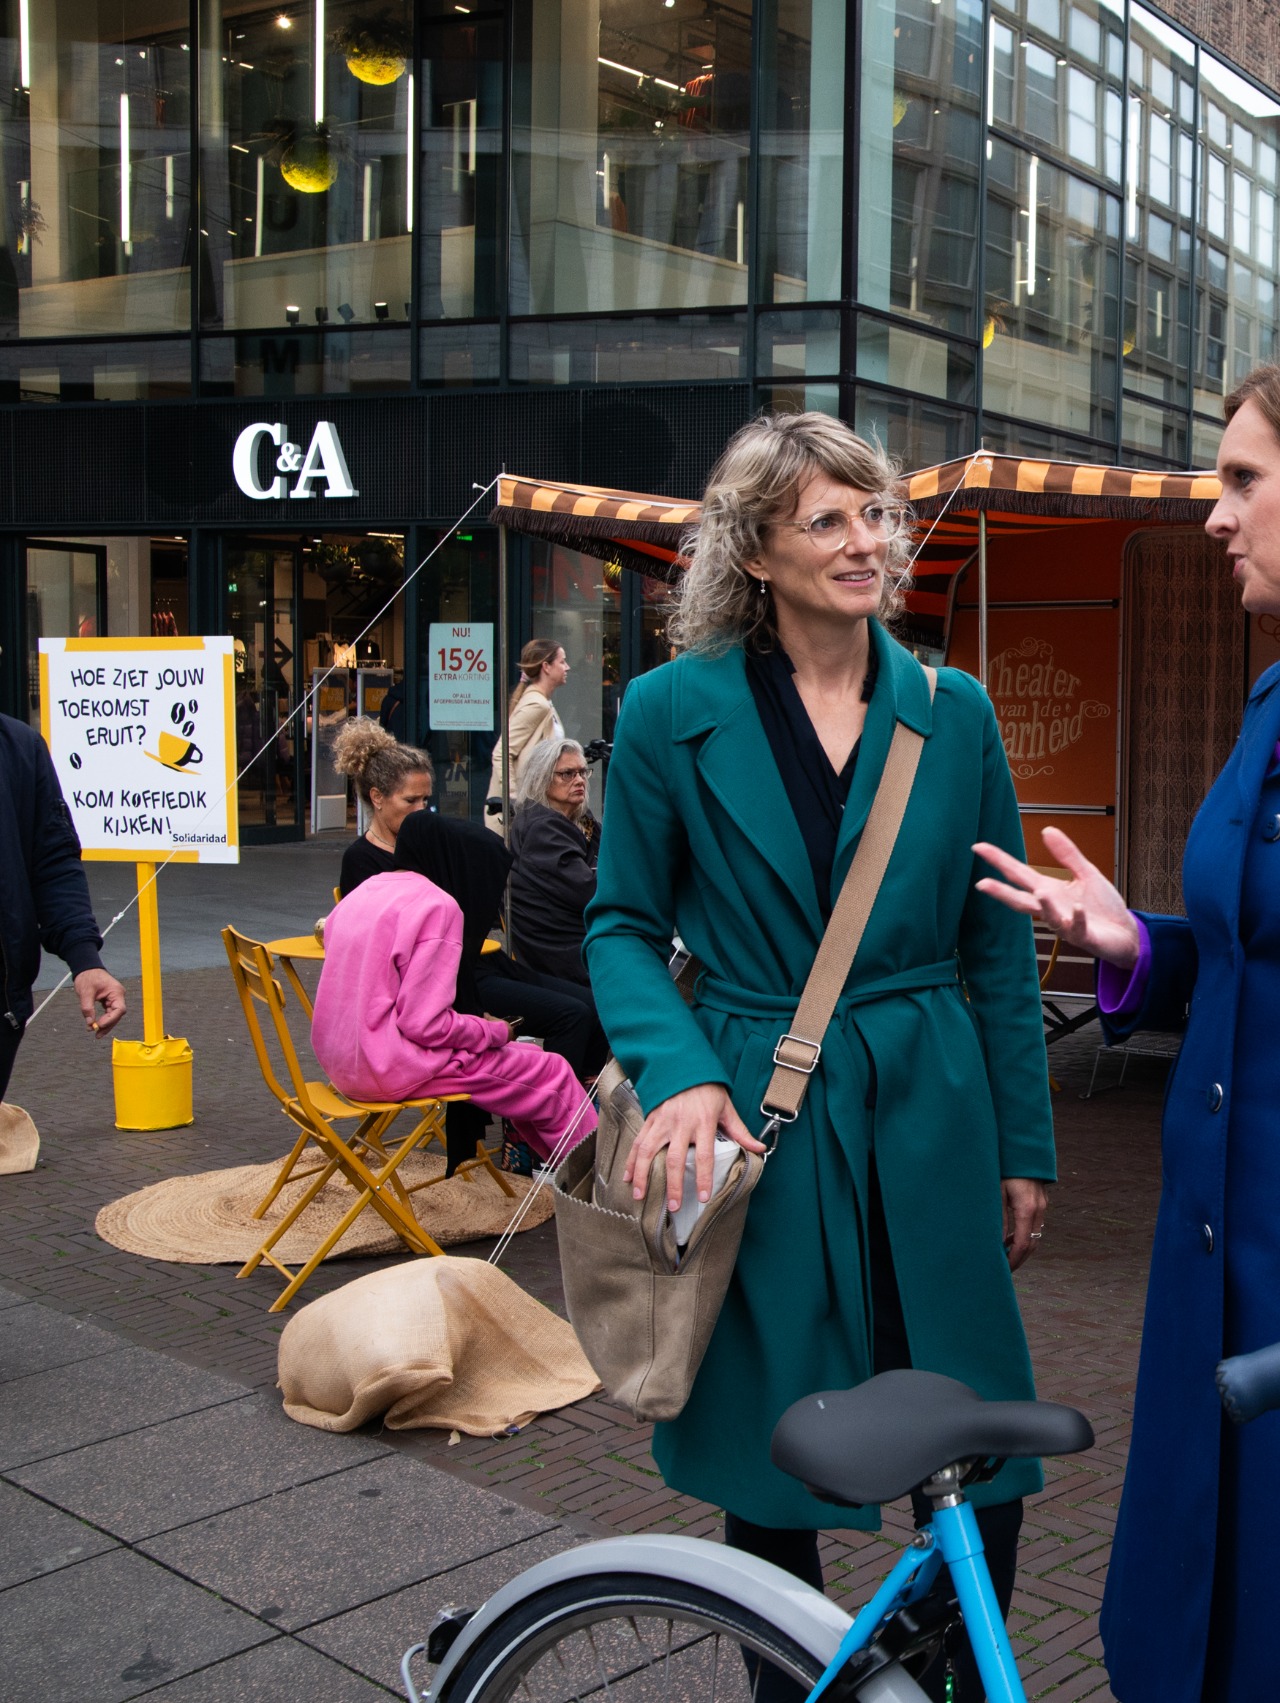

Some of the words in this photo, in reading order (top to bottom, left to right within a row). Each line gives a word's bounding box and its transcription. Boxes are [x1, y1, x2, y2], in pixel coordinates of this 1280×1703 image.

[232, 421, 359, 499] C&A
[452, 627, 470, 638] NU!
[438, 648, 487, 672] 15%
[71, 668, 106, 688] HOE
[113, 669, 148, 689] ZIET
[155, 667, 205, 690] JOUW
[434, 673, 458, 681] EXTRA
[458, 673, 490, 681] KORTING
[987, 651, 1081, 698] Theater
[58, 699, 150, 718] TOEKOMST
[1000, 704, 1027, 717] van
[1041, 699, 1061, 717] de
[86, 725, 146, 746] ERUIT?
[72, 790, 114, 808] KOM
[103, 814, 172, 835] KIJKEN!
[172, 833, 226, 844] Solidaridad
